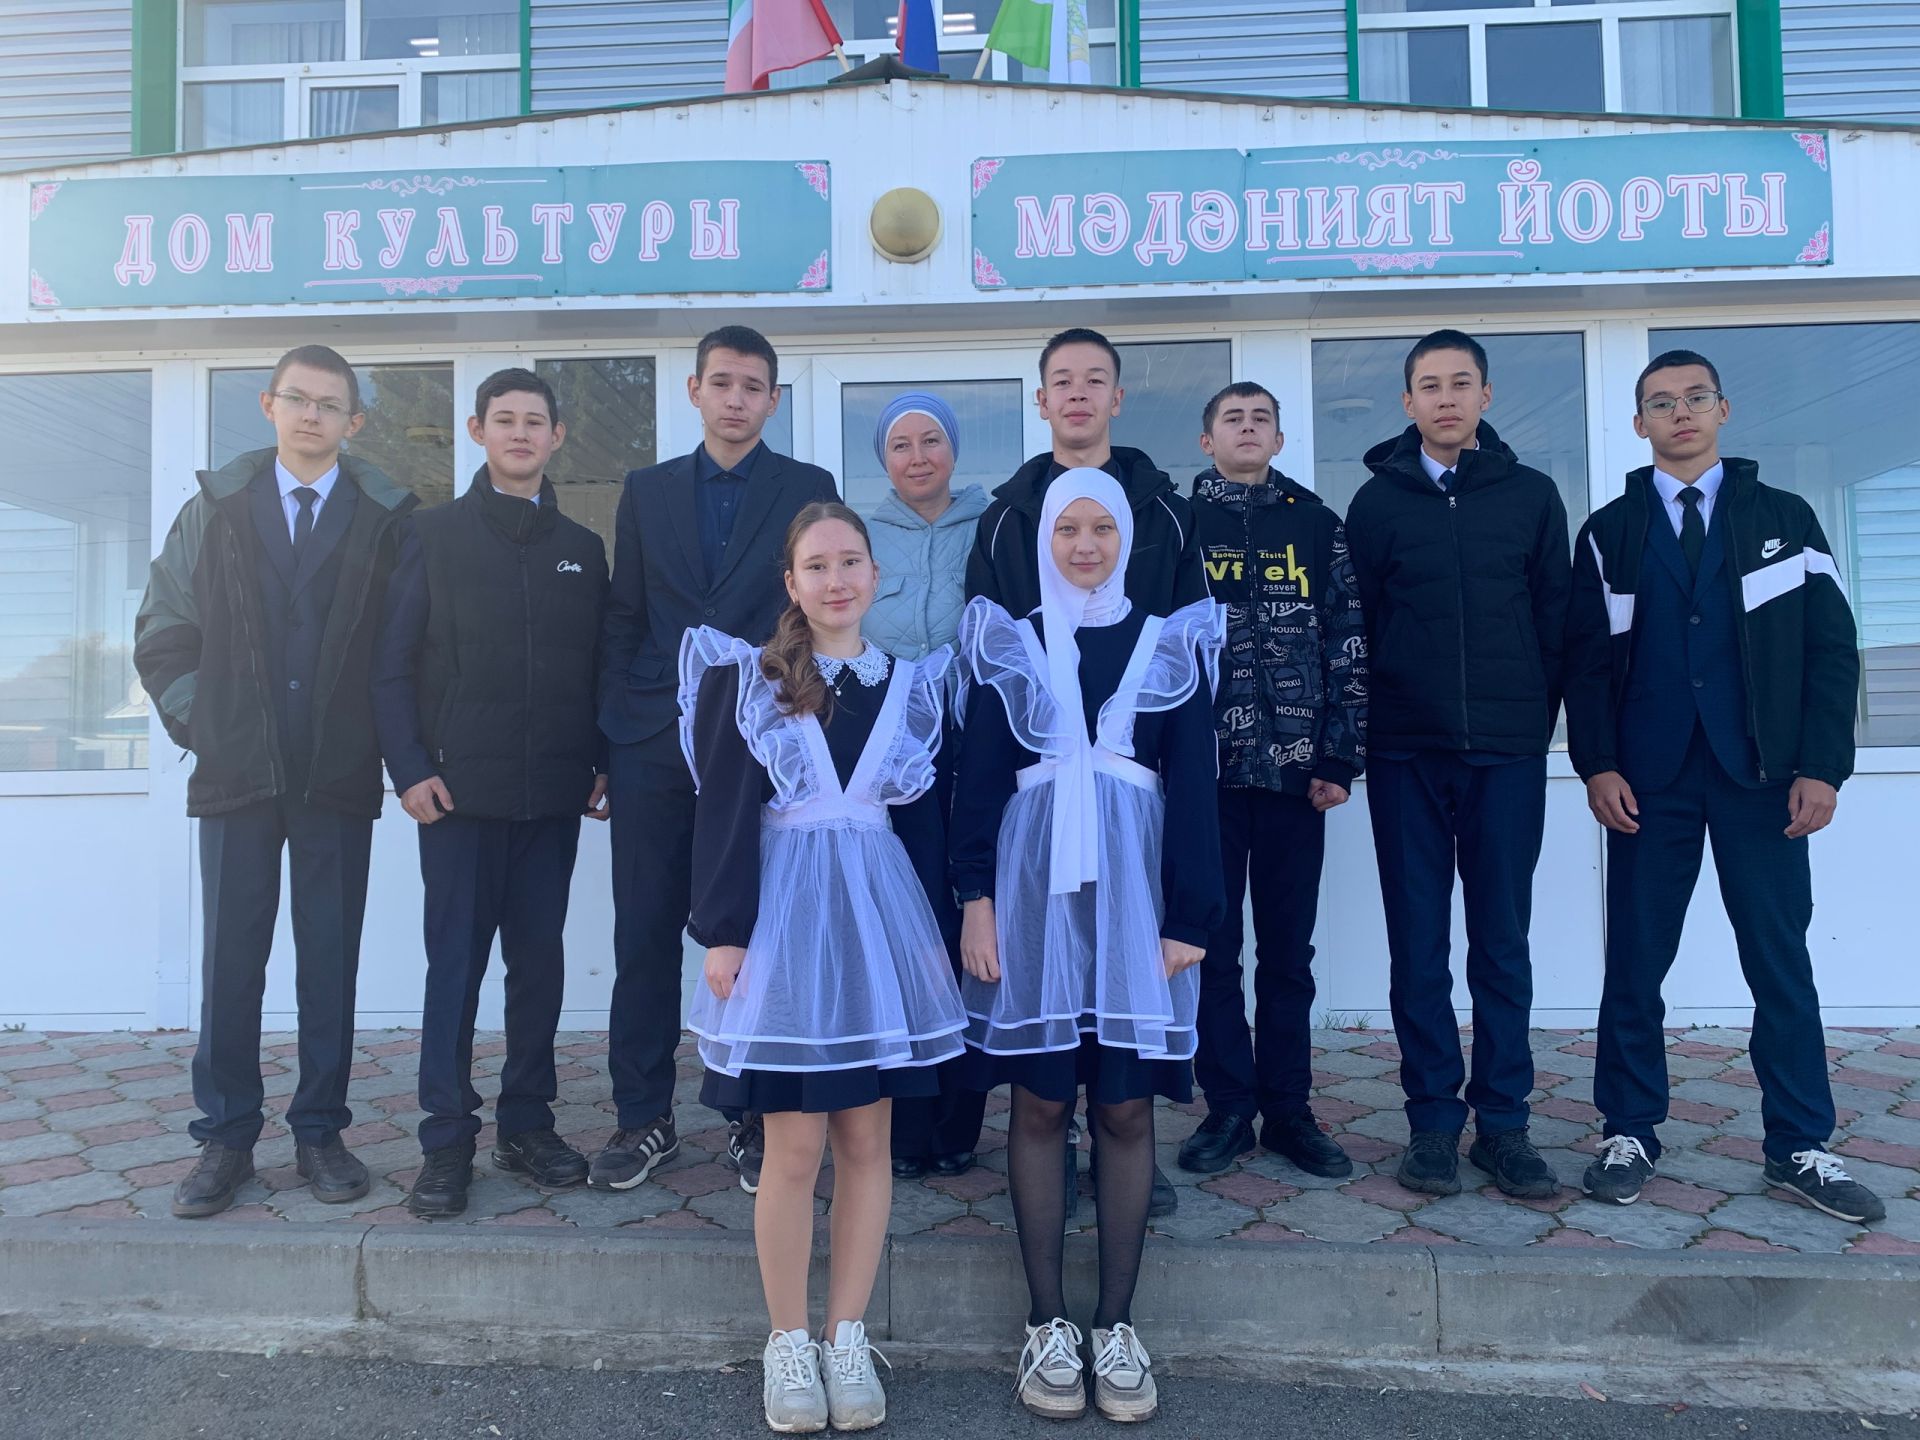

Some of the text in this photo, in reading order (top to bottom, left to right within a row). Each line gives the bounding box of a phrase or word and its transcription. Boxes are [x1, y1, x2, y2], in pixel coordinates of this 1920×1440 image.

[113, 198, 741, 286] ДОМ КУЛЬТУРЫ
[1014, 158, 1789, 268] МӘДӘНИЯТ ЙОРТЫ
